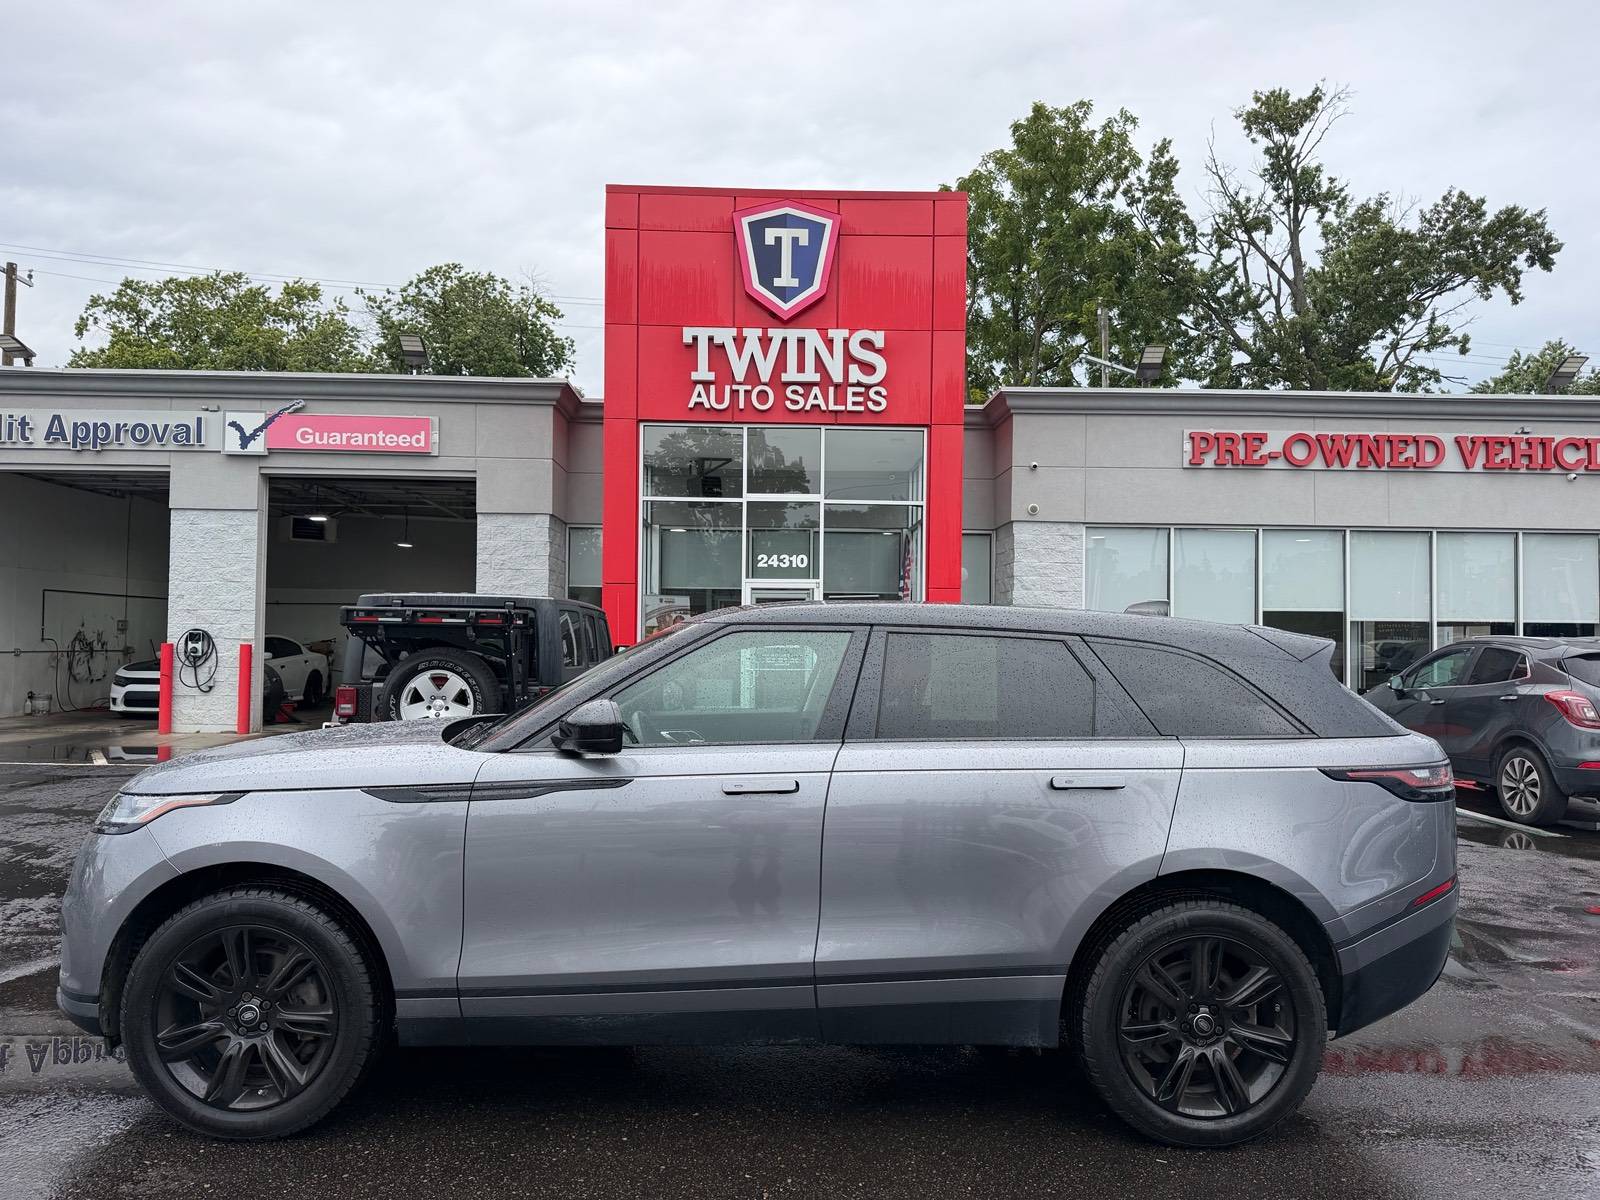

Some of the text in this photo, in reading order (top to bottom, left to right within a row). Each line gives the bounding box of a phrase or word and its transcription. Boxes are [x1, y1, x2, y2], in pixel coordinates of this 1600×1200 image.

[764, 227, 809, 288] T
[682, 326, 888, 387] TWINS
[687, 384, 888, 412] AUTO SALES
[43, 413, 204, 450] Approval
[295, 427, 426, 448] Guaranteed
[1189, 431, 1446, 468] PRE-OWNED
[757, 554, 808, 568] 24310
